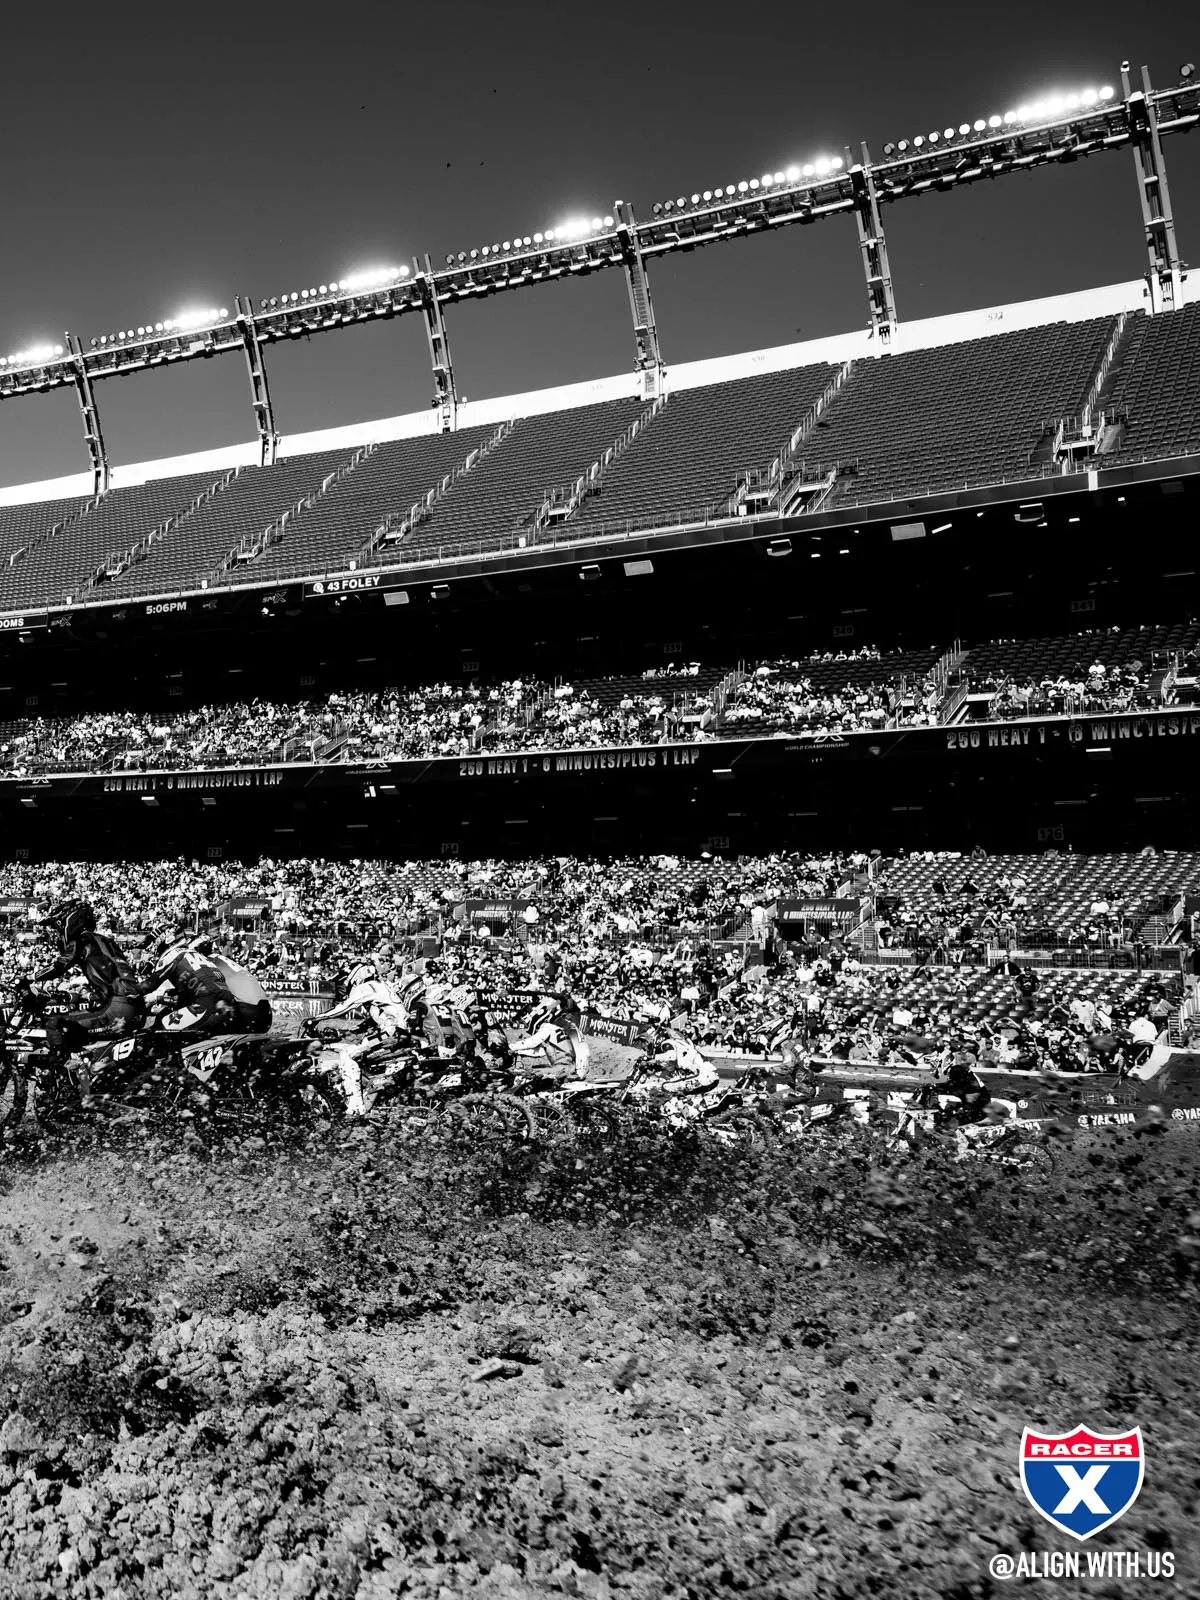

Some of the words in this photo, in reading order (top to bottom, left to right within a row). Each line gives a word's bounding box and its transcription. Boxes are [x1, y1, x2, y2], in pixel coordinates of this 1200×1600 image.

[327, 582, 341, 591] 43
[341, 576, 381, 590] FOLEY
[146, 601, 188, 615] 5:06PM
[946, 730, 980, 750] 250
[987, 727, 1031, 747] HEAT
[1039, 726, 1046, 744] 1
[459, 761, 483, 777] 250
[488, 759, 517, 775] HEAT
[521, 758, 528, 773] 1
[661, 751, 668, 766] 1
[673, 749, 700, 765] LAP
[152, 777, 157, 790] 1
[255, 773, 260, 786] 1
[263, 771, 284, 785] LAP
[589, 1018, 628, 1036] MONSTER
[112, 1038, 136, 1062] 19
